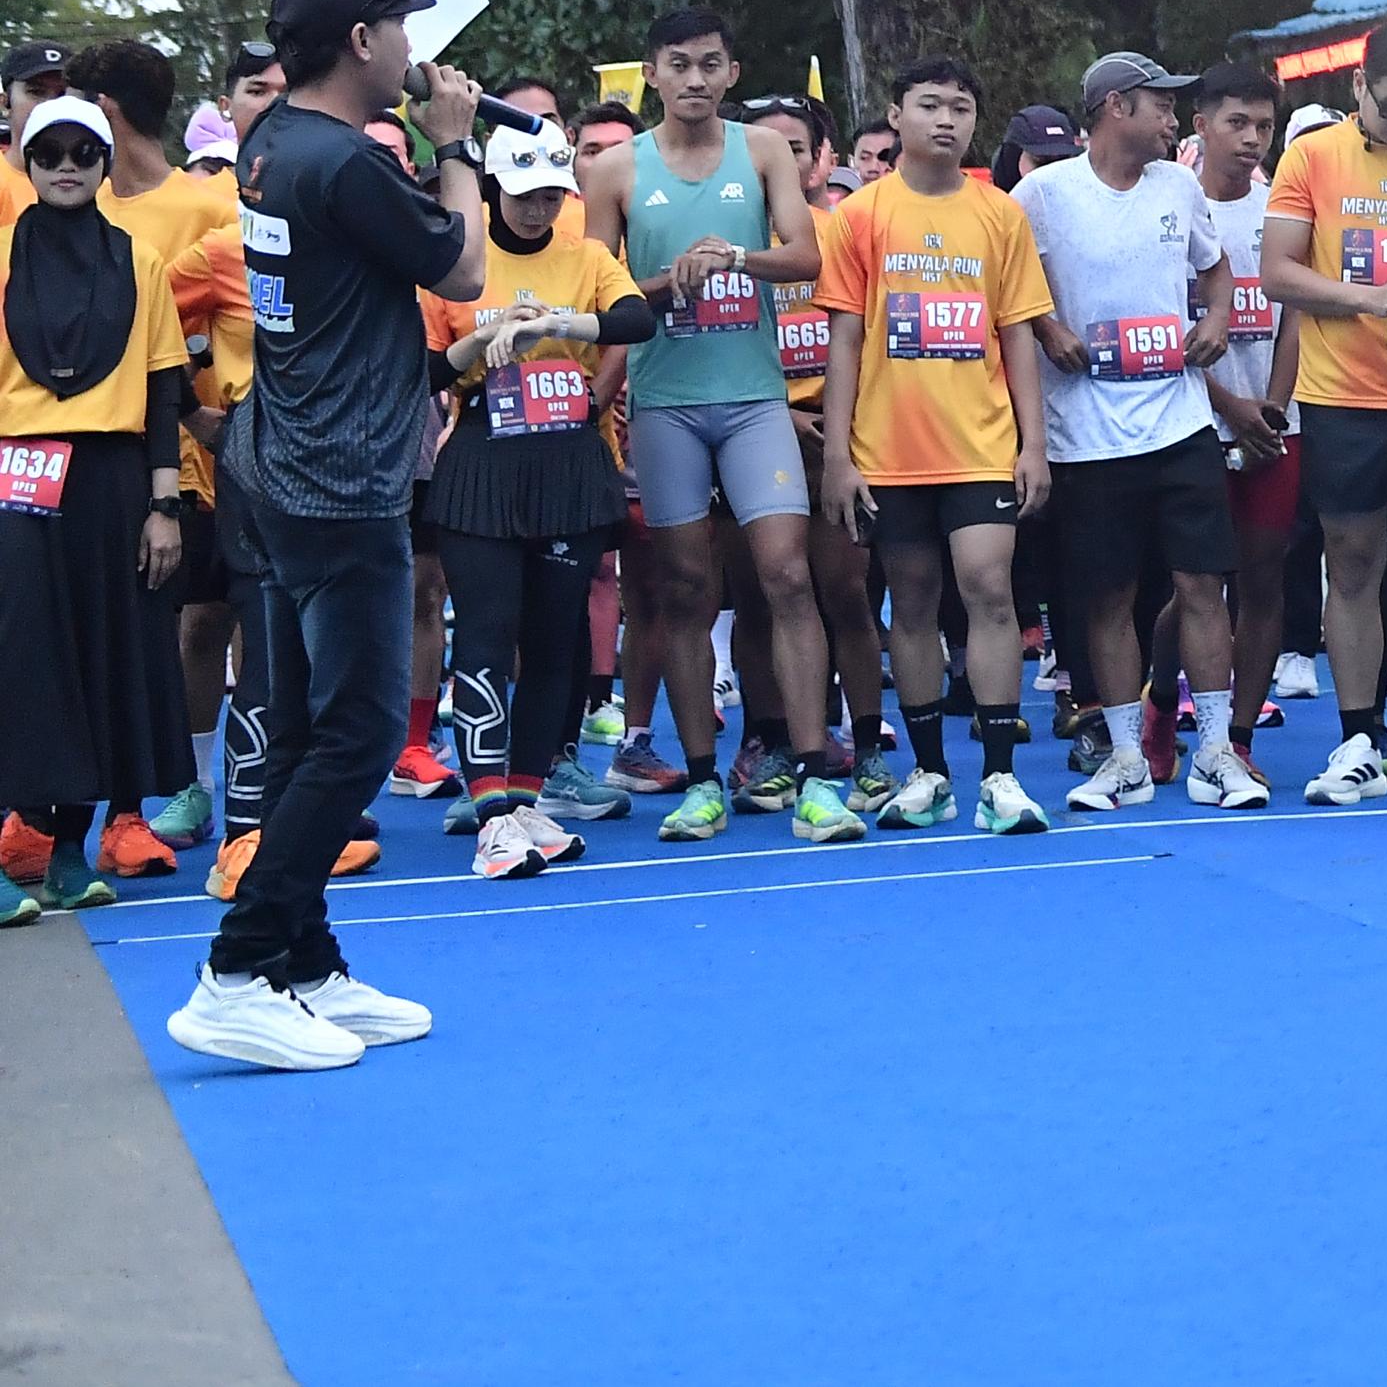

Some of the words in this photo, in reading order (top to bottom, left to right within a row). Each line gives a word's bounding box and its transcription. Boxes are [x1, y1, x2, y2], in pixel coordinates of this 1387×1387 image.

[884, 253, 950, 273] MENYALA
[952, 256, 983, 278] RUN
[702, 272, 755, 302] 1645
[1233, 286, 1268, 311] 618
[719, 302, 741, 314] OPEN
[925, 301, 982, 328] 1577
[777, 320, 831, 350] 1665
[943, 330, 965, 341] OPEN
[1125, 324, 1178, 354] 1591
[1142, 354, 1164, 366] OPEN
[526, 370, 584, 400] 1663
[547, 401, 570, 412] OPEN
[0, 445, 65, 483] 1634
[11, 480, 38, 494] OPEN
